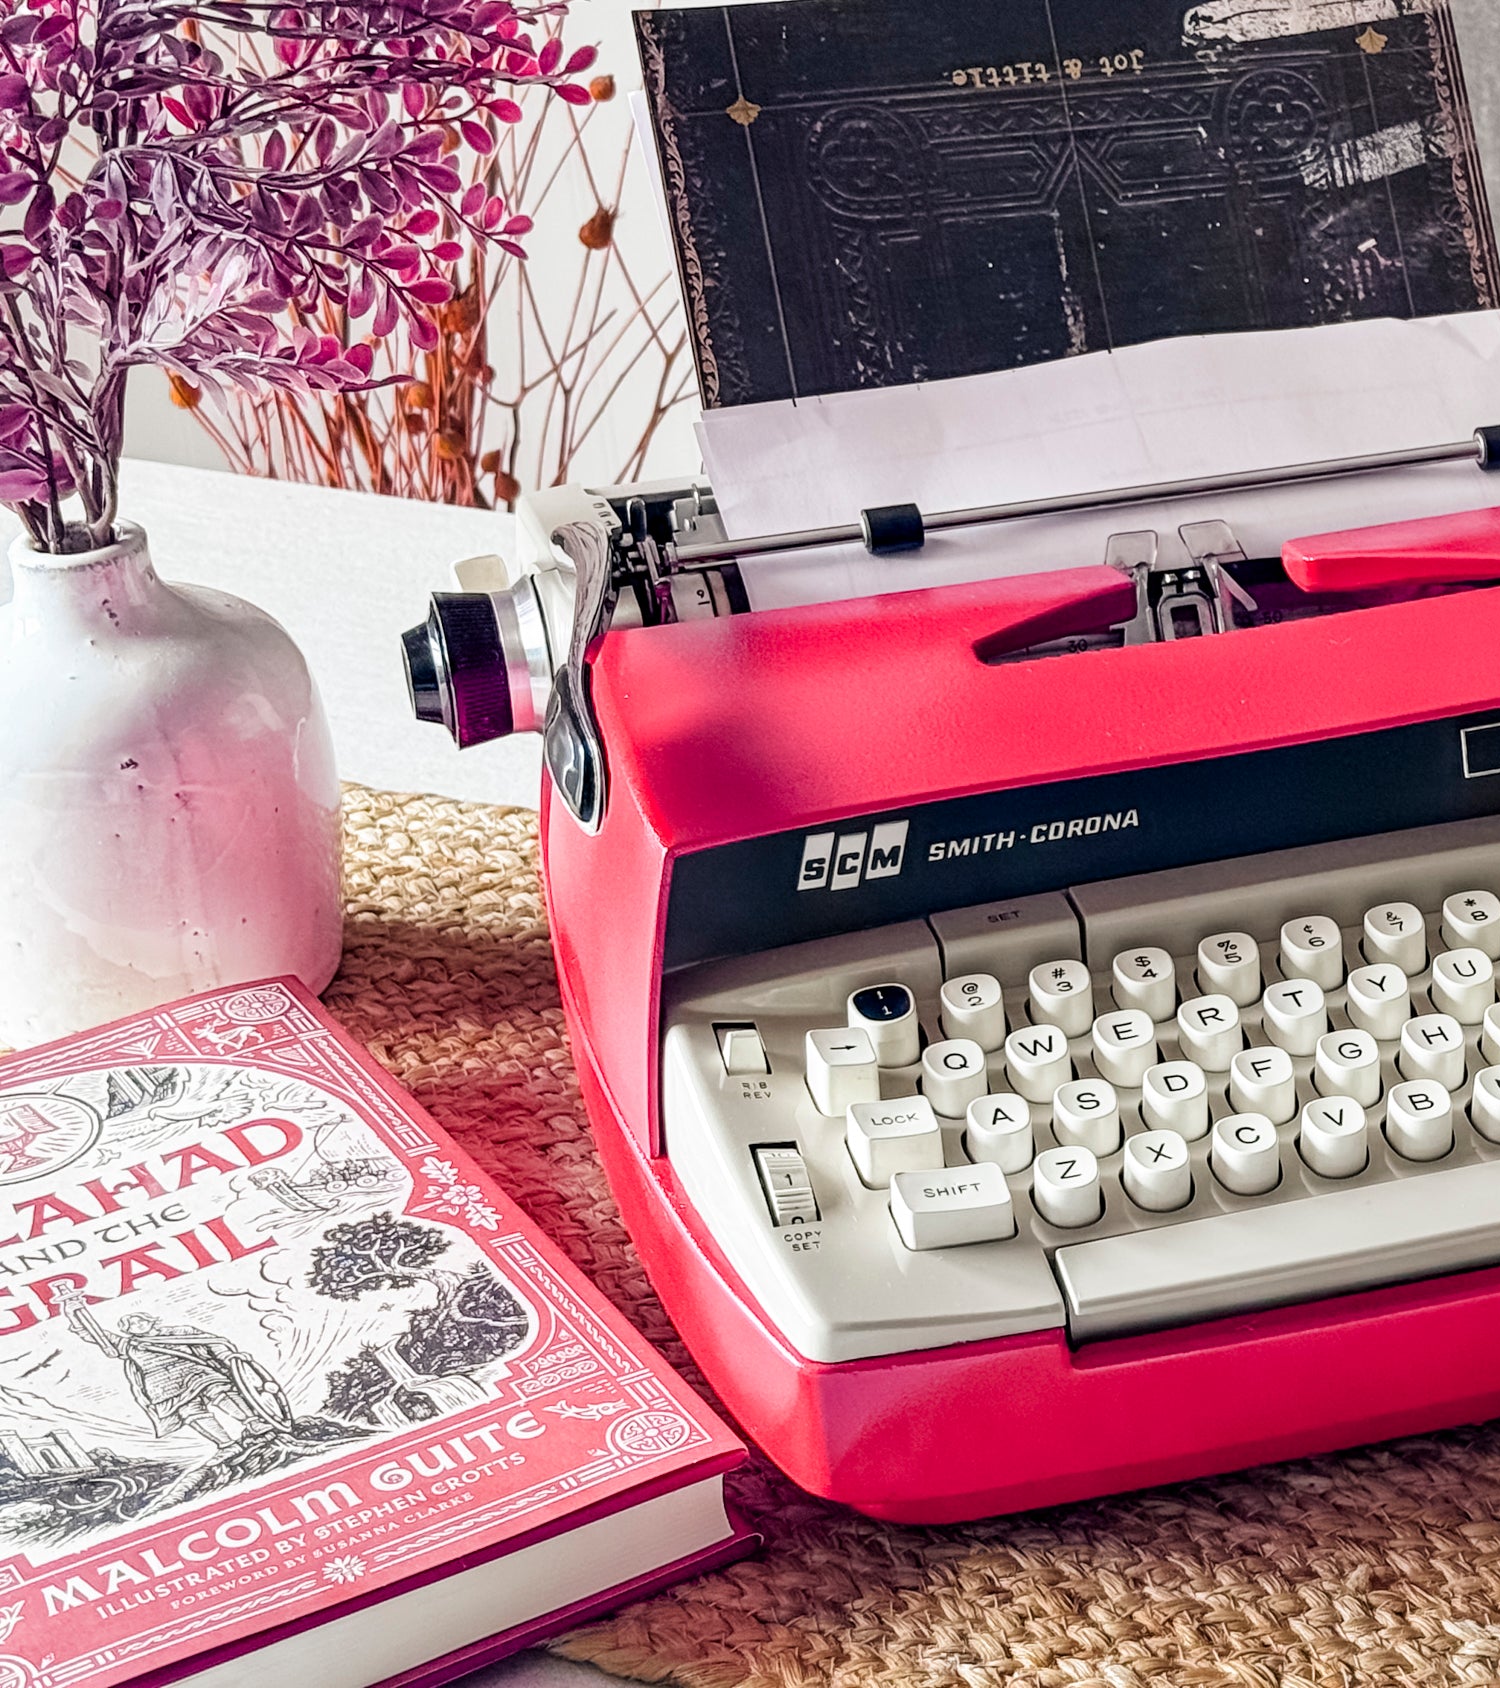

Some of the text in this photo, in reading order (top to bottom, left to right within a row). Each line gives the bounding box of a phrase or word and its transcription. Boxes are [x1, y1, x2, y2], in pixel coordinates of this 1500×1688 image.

[952, 49, 1144, 88] jot & tittle
[799, 836, 905, 886] SCM
[987, 909, 1022, 923] SET
[1470, 910, 1489, 922] 8
[1308, 936, 1325, 947] 6
[1134, 955, 1151, 968] $
[1224, 952, 1242, 963] 5
[1051, 967, 1066, 979] #
[1141, 968, 1158, 978] 4
[1452, 959, 1477, 978] U
[961, 982, 979, 995] @
[1056, 981, 1073, 992] 3
[1366, 975, 1386, 992] Y
[967, 996, 982, 1007] 2
[1282, 990, 1303, 1008] T
[882, 1005, 893, 1016] 1
[1196, 1007, 1225, 1026] R
[1111, 1021, 1138, 1041] E
[1421, 1026, 1449, 1045] H
[1017, 1035, 1053, 1057] W
[1338, 1042, 1363, 1060] G
[943, 1052, 969, 1070] Q
[1250, 1058, 1272, 1078] F
[741, 1081, 768, 1091] RIB
[1163, 1074, 1189, 1092] D
[743, 1090, 772, 1100] REV
[1076, 1092, 1100, 1110] S
[1407, 1093, 1434, 1111] B
[870, 1112, 919, 1127] LOCK
[992, 1107, 1014, 1126] A
[1322, 1108, 1344, 1126] V
[1235, 1126, 1260, 1144] C
[1146, 1143, 1172, 1163] X
[1055, 1159, 1080, 1180] Z
[923, 1183, 979, 1198] SHIFT
[93, 1203, 191, 1243] THE
[783, 1230, 822, 1243] COPY
[791, 1241, 822, 1252] SET
[41, 1410, 547, 1617] MALCOLM GUITE
[96, 1451, 526, 1620] ILLUSTRATED BY STEPHEN CROTTS
[170, 1491, 475, 1610] FOREWORD BY SUSANNA CLARKE
